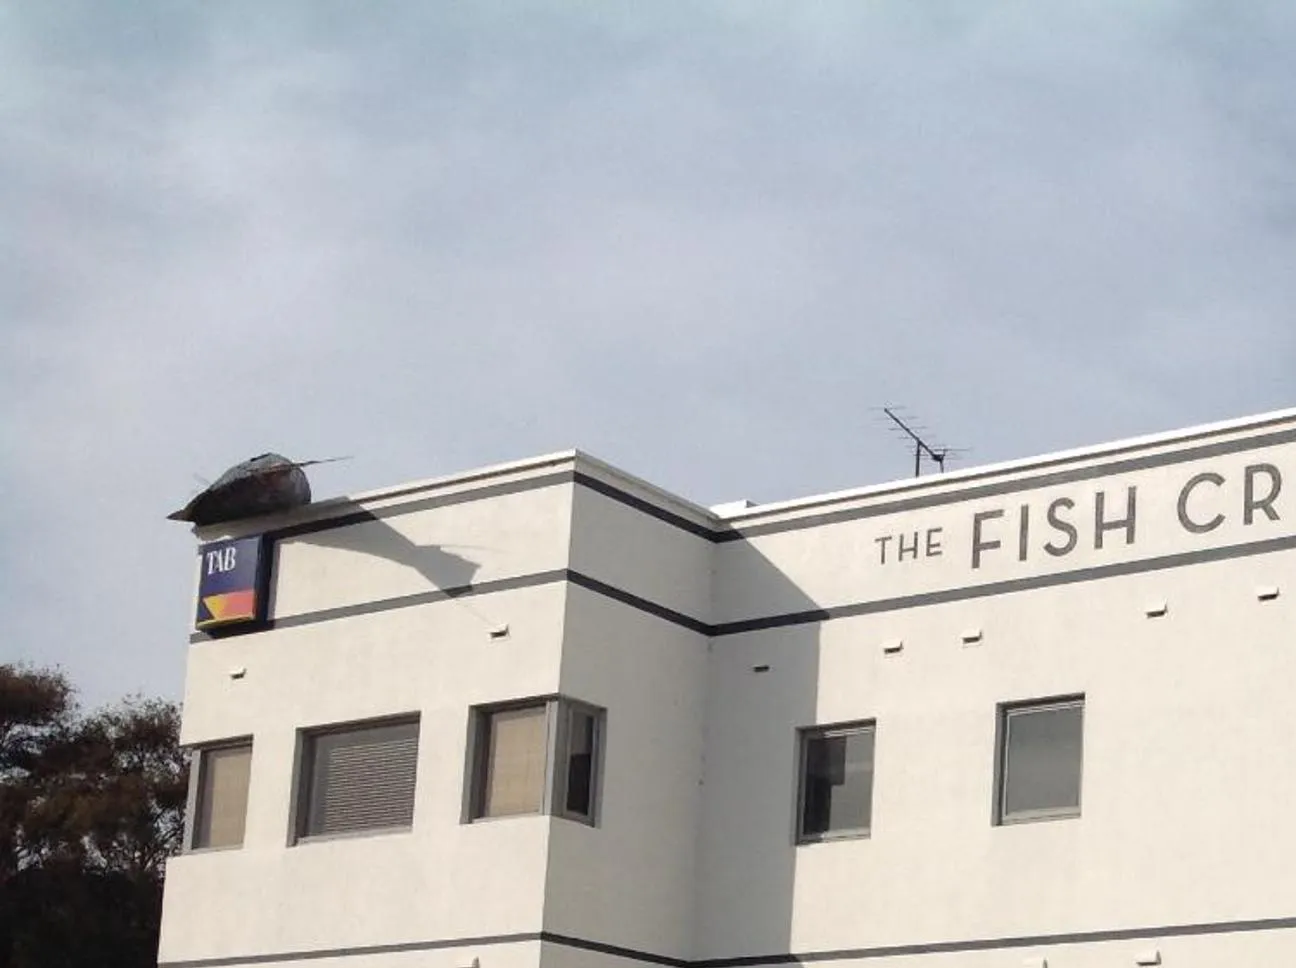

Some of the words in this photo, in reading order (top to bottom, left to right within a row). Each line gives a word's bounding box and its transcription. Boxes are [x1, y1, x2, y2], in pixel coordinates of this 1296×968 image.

[874, 527, 943, 565] THE
[970, 486, 1137, 569] FISH
[205, 546, 237, 575] TAB
